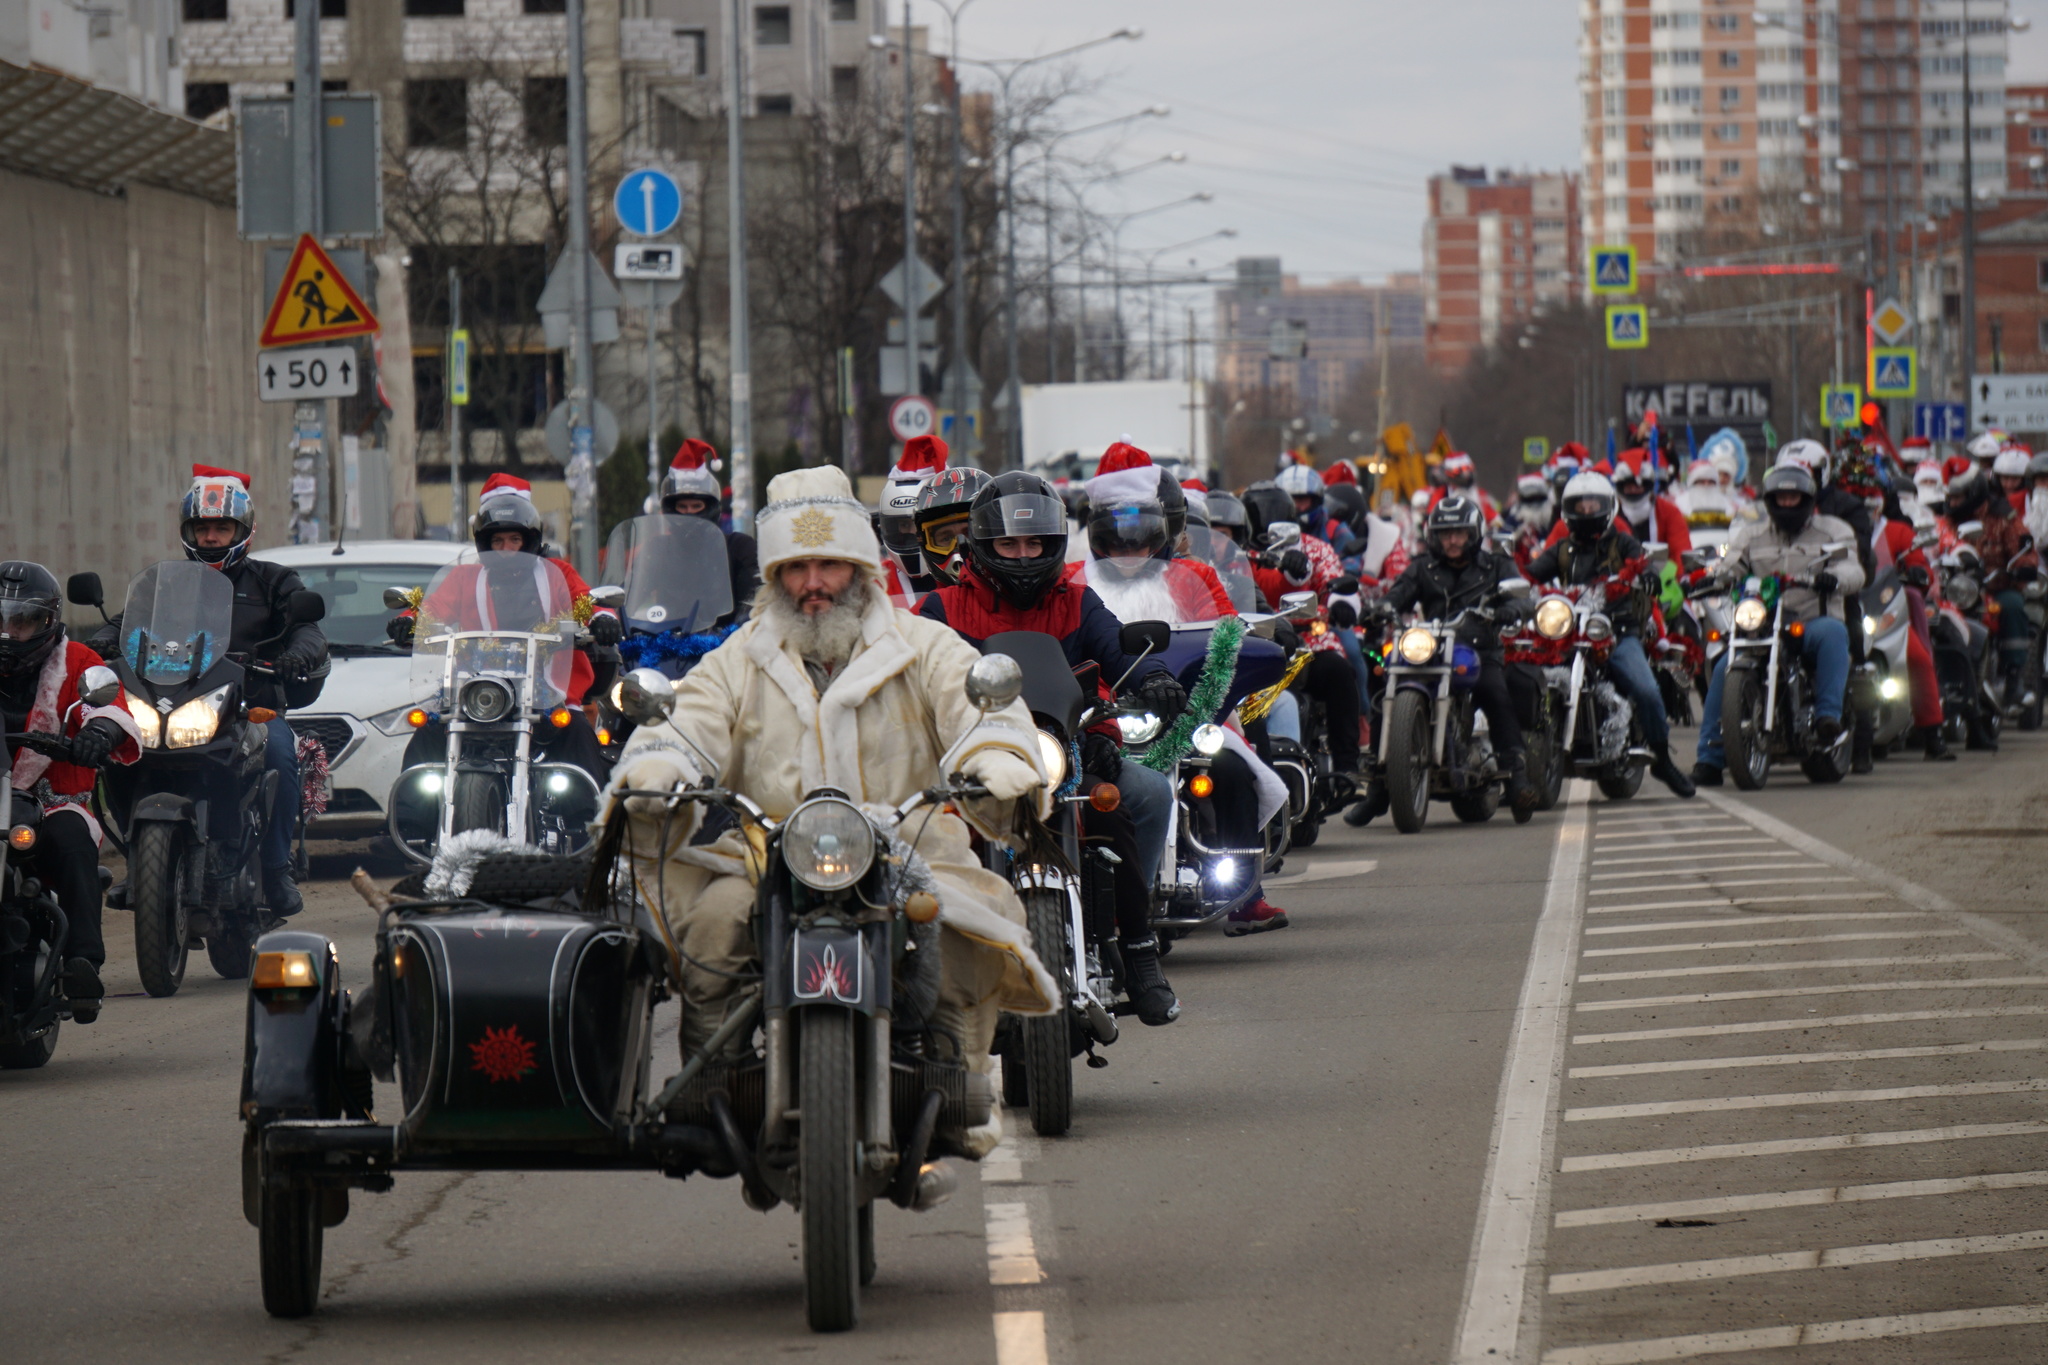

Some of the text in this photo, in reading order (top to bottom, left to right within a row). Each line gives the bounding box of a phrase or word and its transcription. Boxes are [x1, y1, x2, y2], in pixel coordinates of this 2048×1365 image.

[288, 359, 327, 390] 50
[899, 409, 928, 429] 40
[893, 498, 917, 506] HJC
